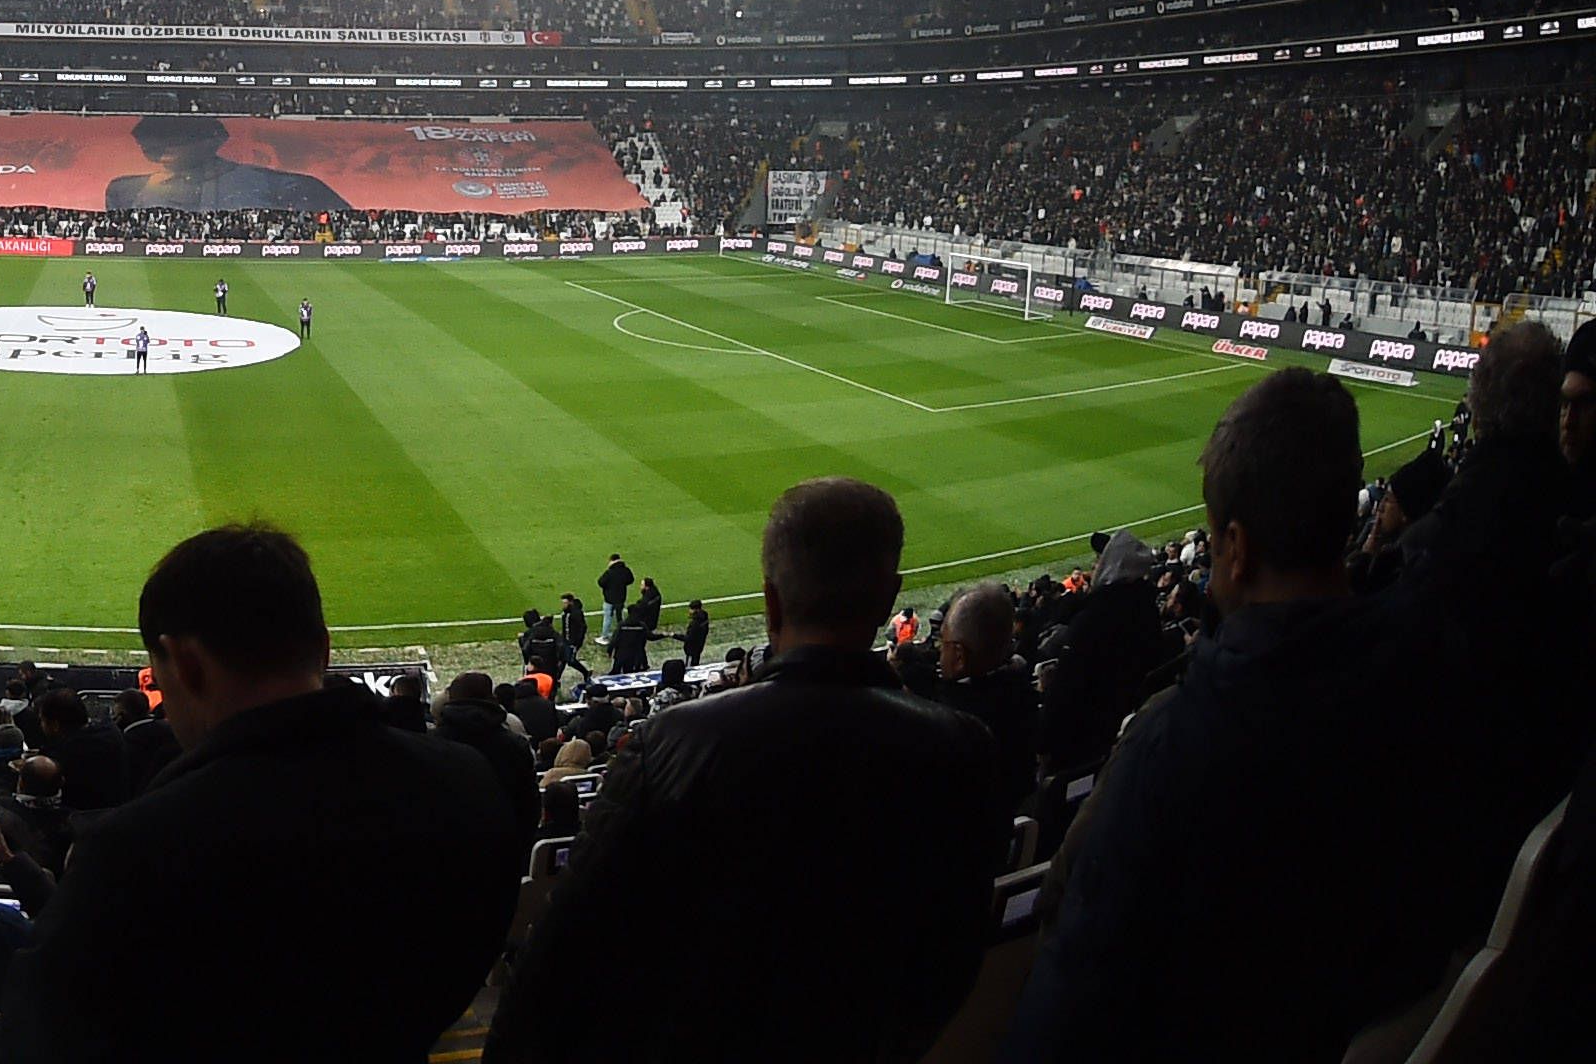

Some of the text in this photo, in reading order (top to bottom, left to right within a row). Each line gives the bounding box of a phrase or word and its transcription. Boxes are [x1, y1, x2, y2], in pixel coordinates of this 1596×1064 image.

[229, 28, 331, 40] DORUKLARIN
[405, 126, 454, 141] 18
[1080, 295, 1113, 310] papara
[1130, 303, 1165, 319] papara
[1181, 312, 1219, 329] papara
[1240, 321, 1279, 338] papara
[1302, 330, 1345, 349] papara
[1215, 338, 1267, 359] ÜLKER
[1369, 340, 1414, 360] papara
